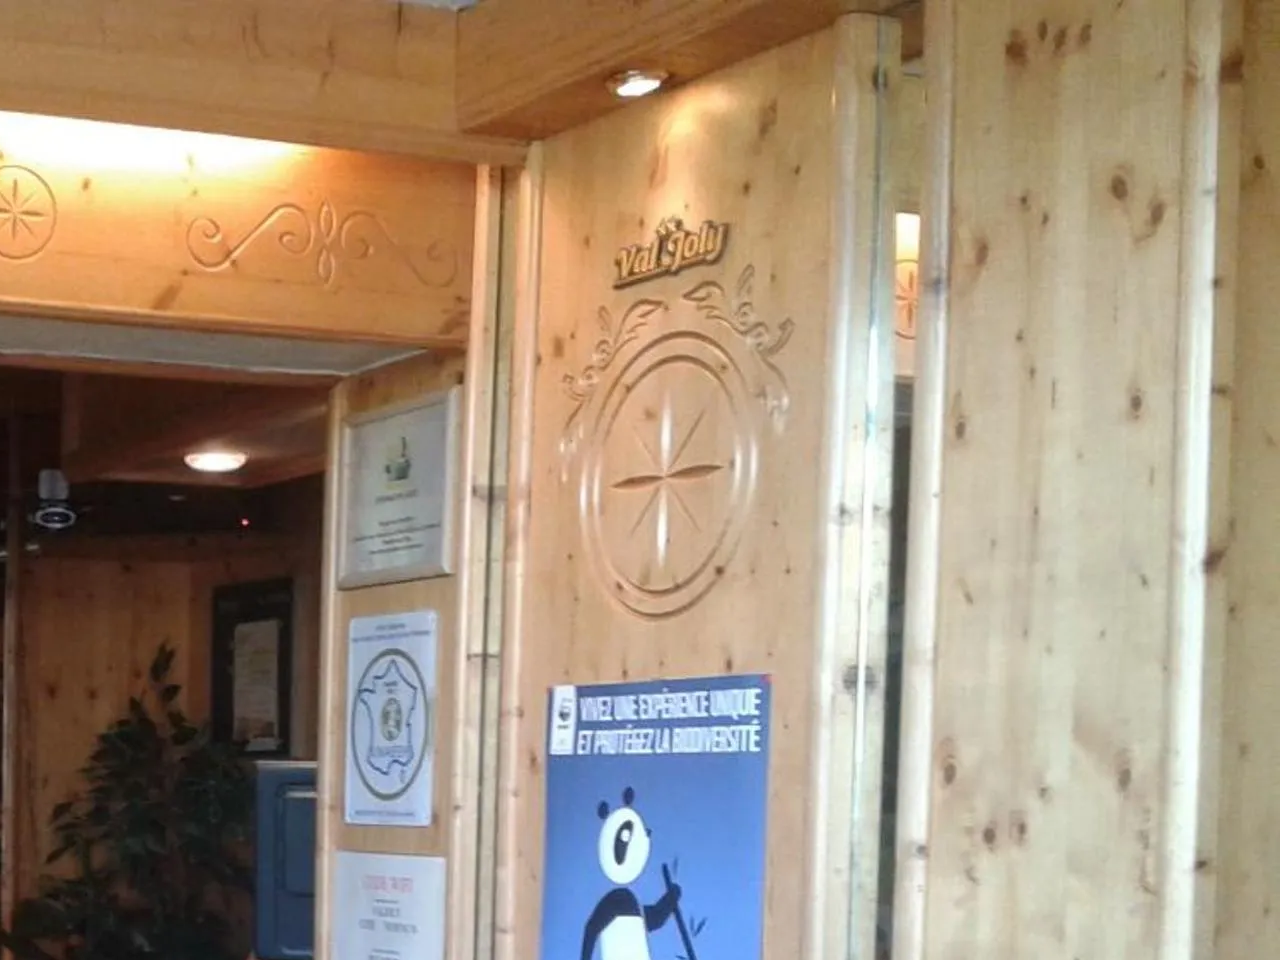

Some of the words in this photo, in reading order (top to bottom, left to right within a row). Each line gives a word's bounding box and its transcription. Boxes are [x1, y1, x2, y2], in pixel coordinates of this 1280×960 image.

[614, 695, 639, 720] UNE
[710, 688, 762, 720] UNIQUE
[577, 729, 593, 755] ET
[655, 728, 670, 753] LA
